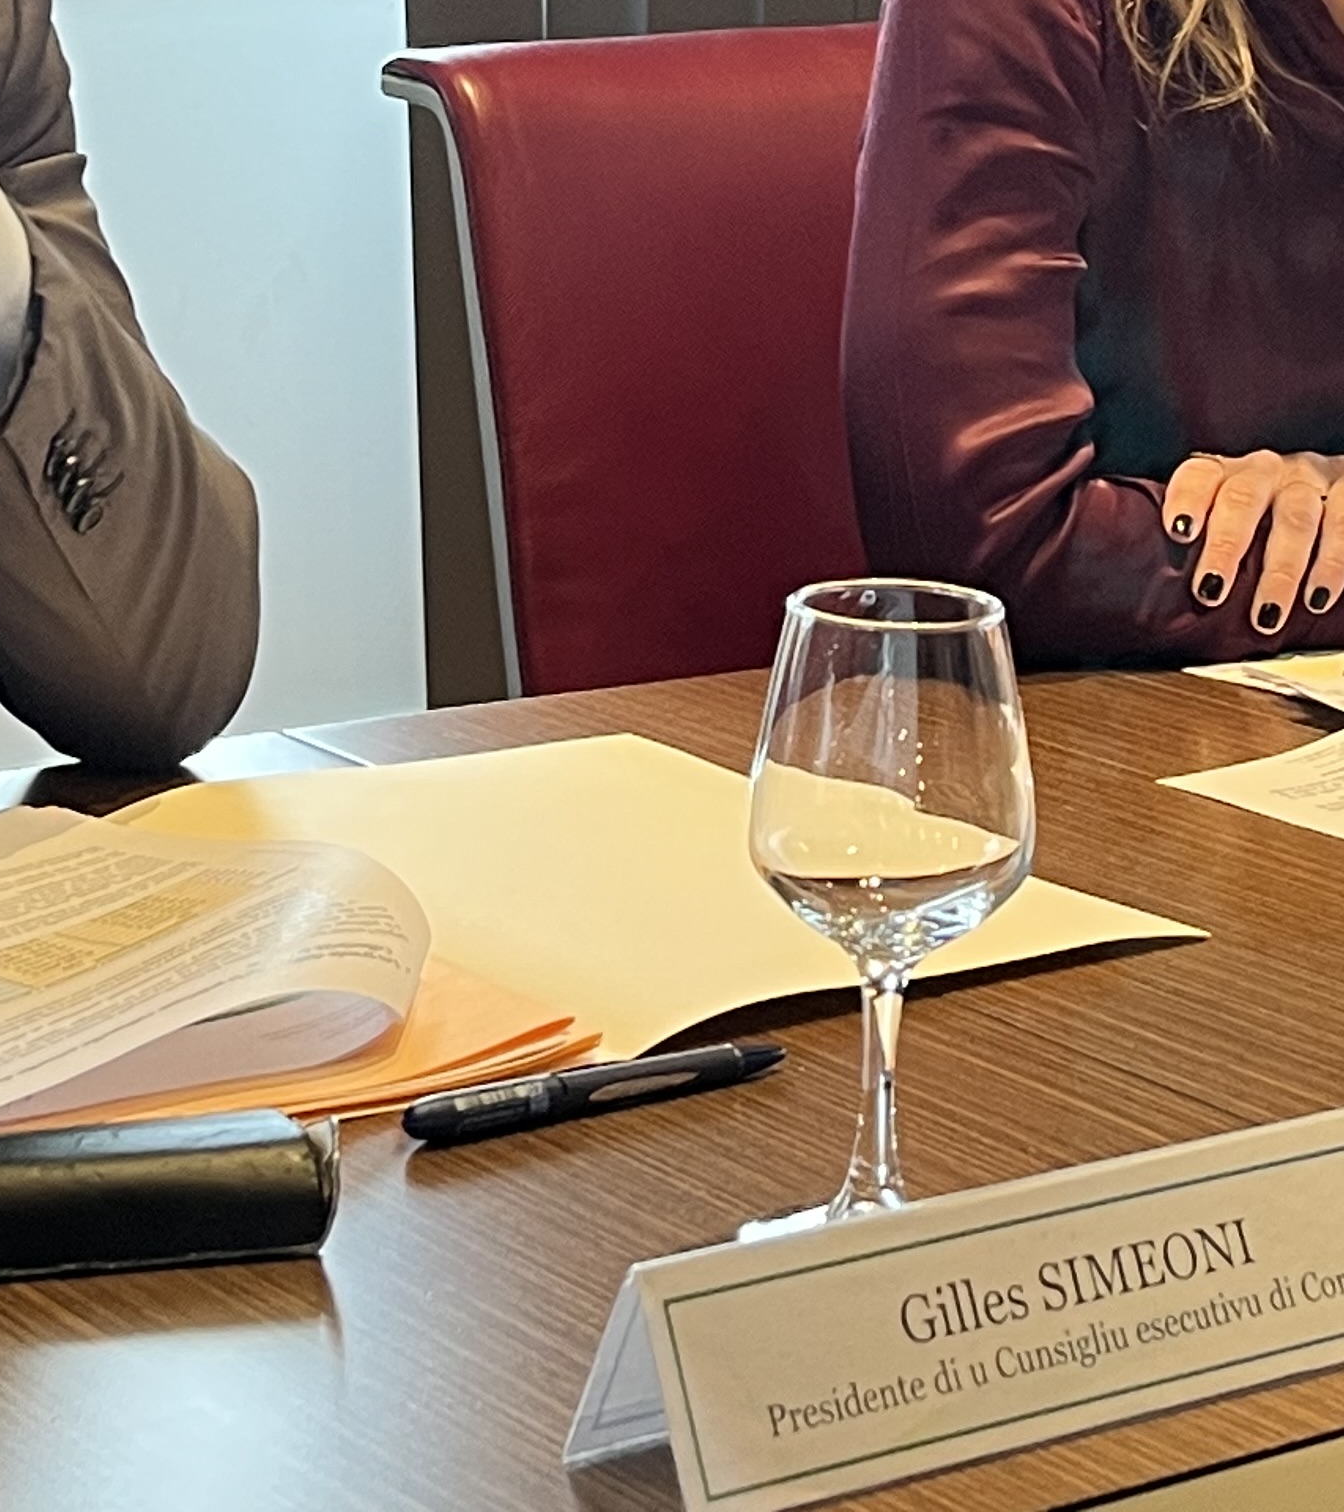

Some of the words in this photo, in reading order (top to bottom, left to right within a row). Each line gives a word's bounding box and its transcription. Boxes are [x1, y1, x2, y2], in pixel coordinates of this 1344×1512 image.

[900, 1278, 1030, 1344] Gilles
[1038, 1218, 1256, 1312] SIMEONI
[767, 1376, 926, 1437] Presidente
[934, 1357, 963, 1395] di
[969, 1361, 988, 1388] u
[995, 1321, 1130, 1378] Cunsigliu
[1136, 1292, 1263, 1345] esecutivu
[1269, 1276, 1296, 1311] di
